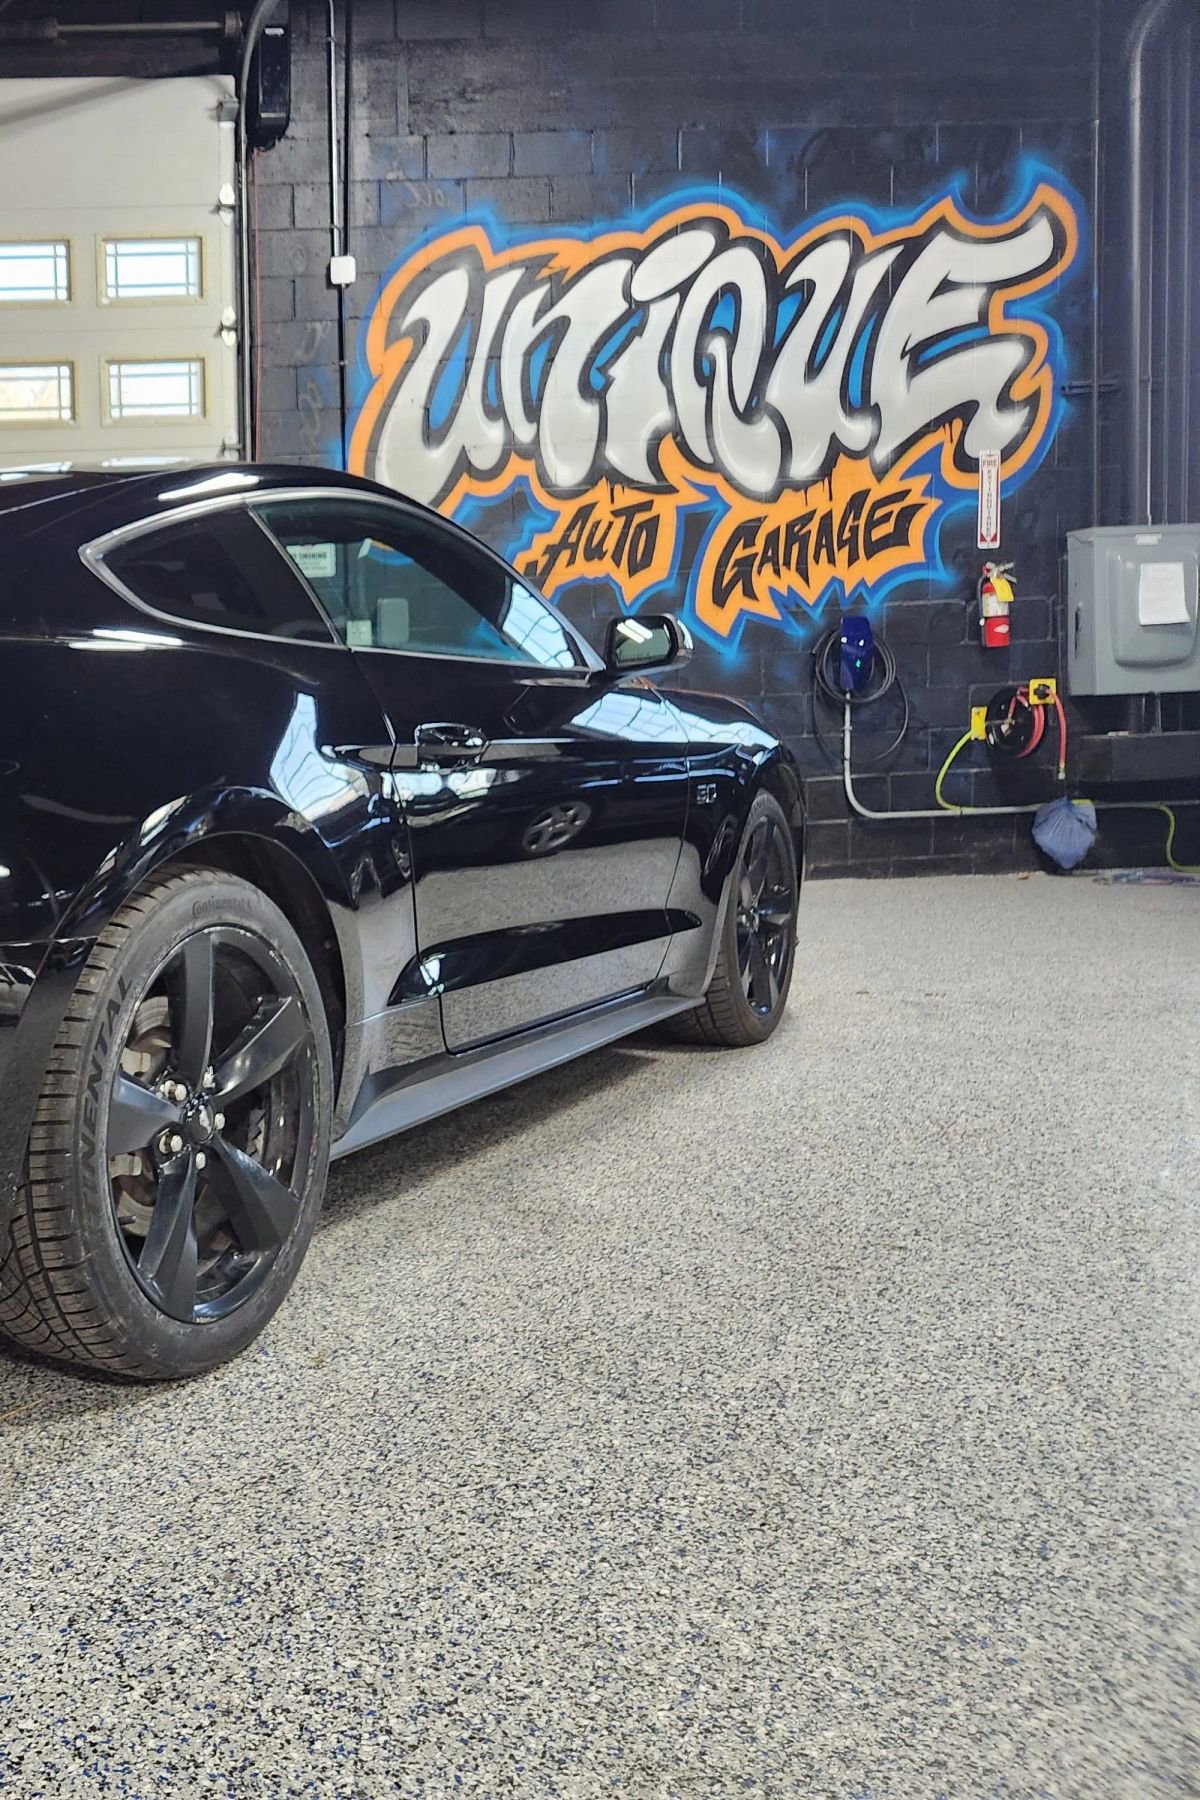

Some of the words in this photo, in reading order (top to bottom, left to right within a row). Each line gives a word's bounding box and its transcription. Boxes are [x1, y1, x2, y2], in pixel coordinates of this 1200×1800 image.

[373, 214, 1056, 506] UNIQUE
[982, 459, 998, 467] FIRE
[537, 499, 662, 583] AUTO
[711, 487, 928, 610] GARAGE
